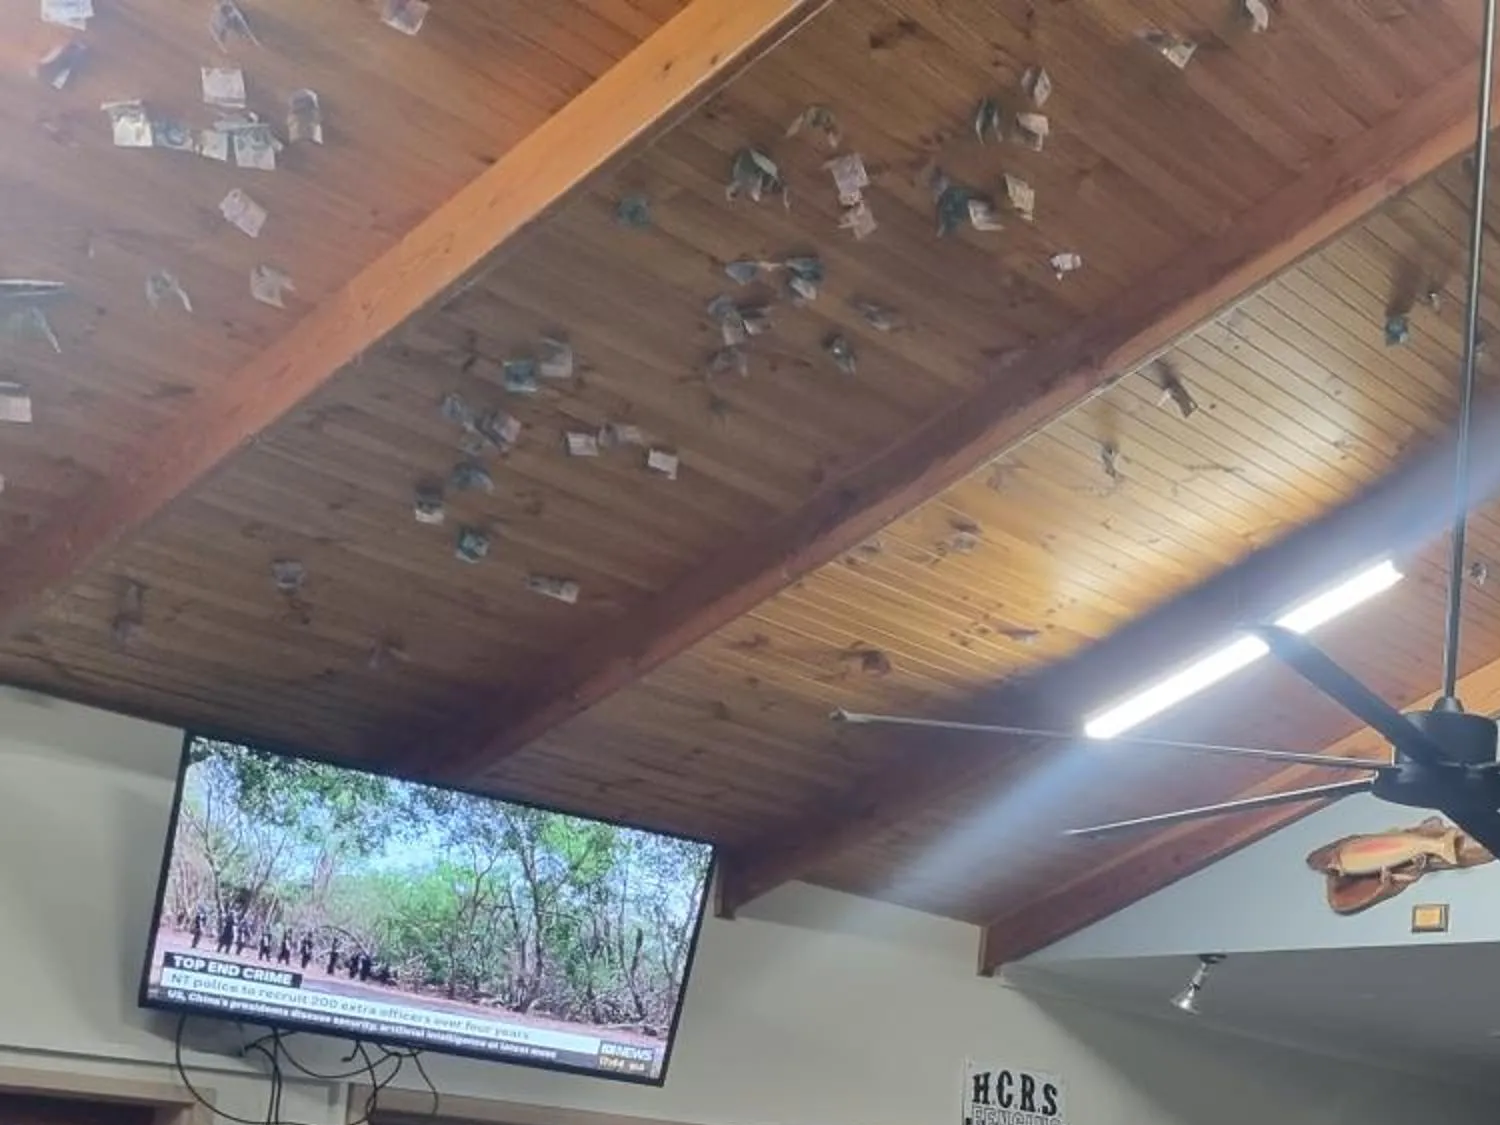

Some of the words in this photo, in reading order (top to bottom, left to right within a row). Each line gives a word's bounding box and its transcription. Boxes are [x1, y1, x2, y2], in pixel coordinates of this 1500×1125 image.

[173, 956, 205, 971] TOP
[207, 962, 240, 977] END
[242, 967, 293, 985] CRIME
[192, 977, 238, 994] police
[242, 984, 256, 995] to
[259, 988, 308, 1004] recruit
[341, 1002, 376, 1015] extra
[379, 1007, 431, 1023] officers
[434, 1017, 463, 1029] over
[494, 1028, 529, 1042] years
